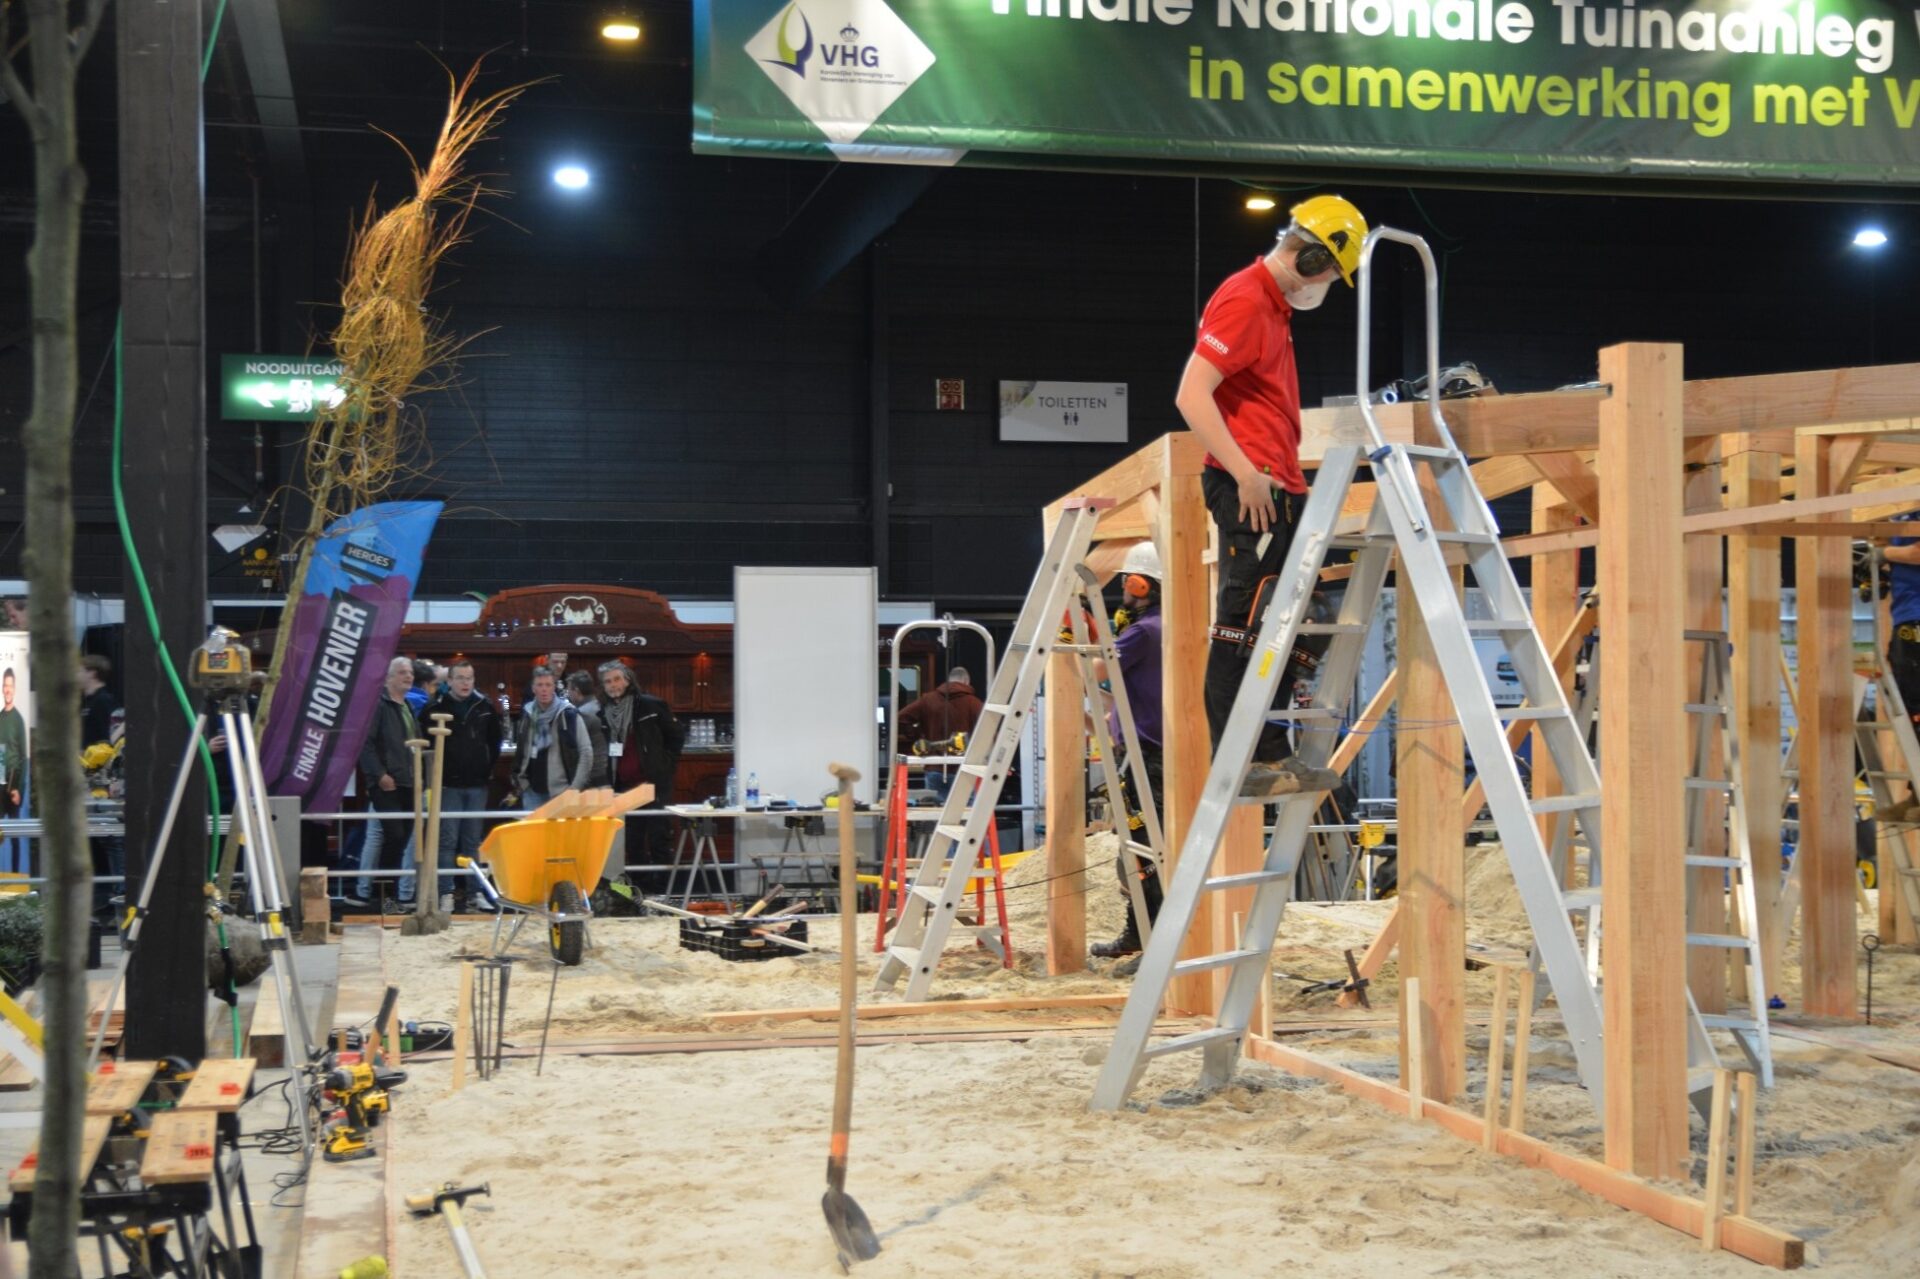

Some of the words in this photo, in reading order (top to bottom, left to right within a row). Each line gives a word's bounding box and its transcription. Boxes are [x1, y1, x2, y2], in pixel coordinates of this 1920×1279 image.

[1217, 0, 1534, 44] Nationale
[820, 44, 879, 68] VHG
[1189, 46, 1245, 100] in
[1267, 61, 1730, 137] samenwerking
[1753, 76, 1870, 127] met
[1039, 396, 1107, 409] TOILETTEN
[347, 546, 390, 567] HEROES
[307, 600, 369, 727] HOVENIER
[293, 727, 325, 782] FINALE
